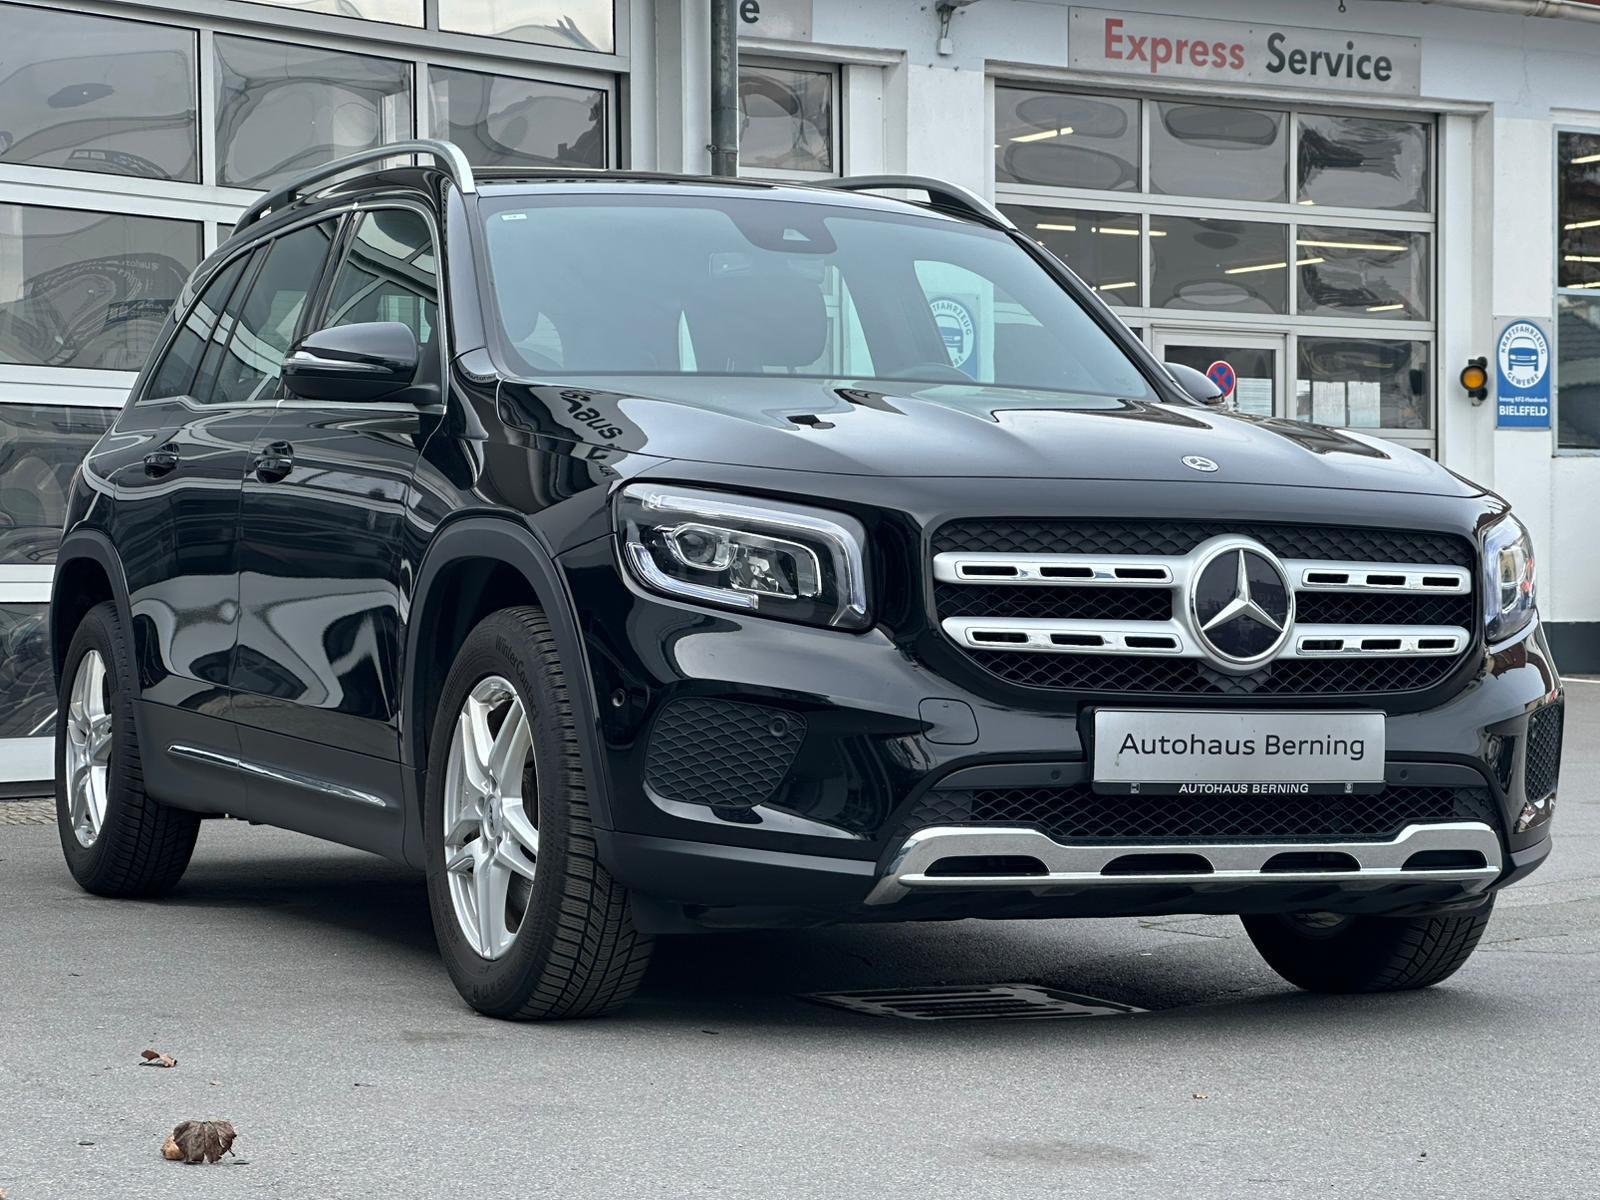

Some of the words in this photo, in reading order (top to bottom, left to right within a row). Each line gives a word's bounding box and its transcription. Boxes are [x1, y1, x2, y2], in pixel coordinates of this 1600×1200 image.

[1104, 18, 1246, 73] Express
[1265, 32, 1393, 82] Service
[1499, 405, 1548, 417] BIELEFELD
[1118, 733, 1256, 755] Autohaus
[1264, 734, 1365, 761] Berning
[1178, 783, 1249, 794] AUTOHAUS
[1252, 783, 1310, 794] BERNING
